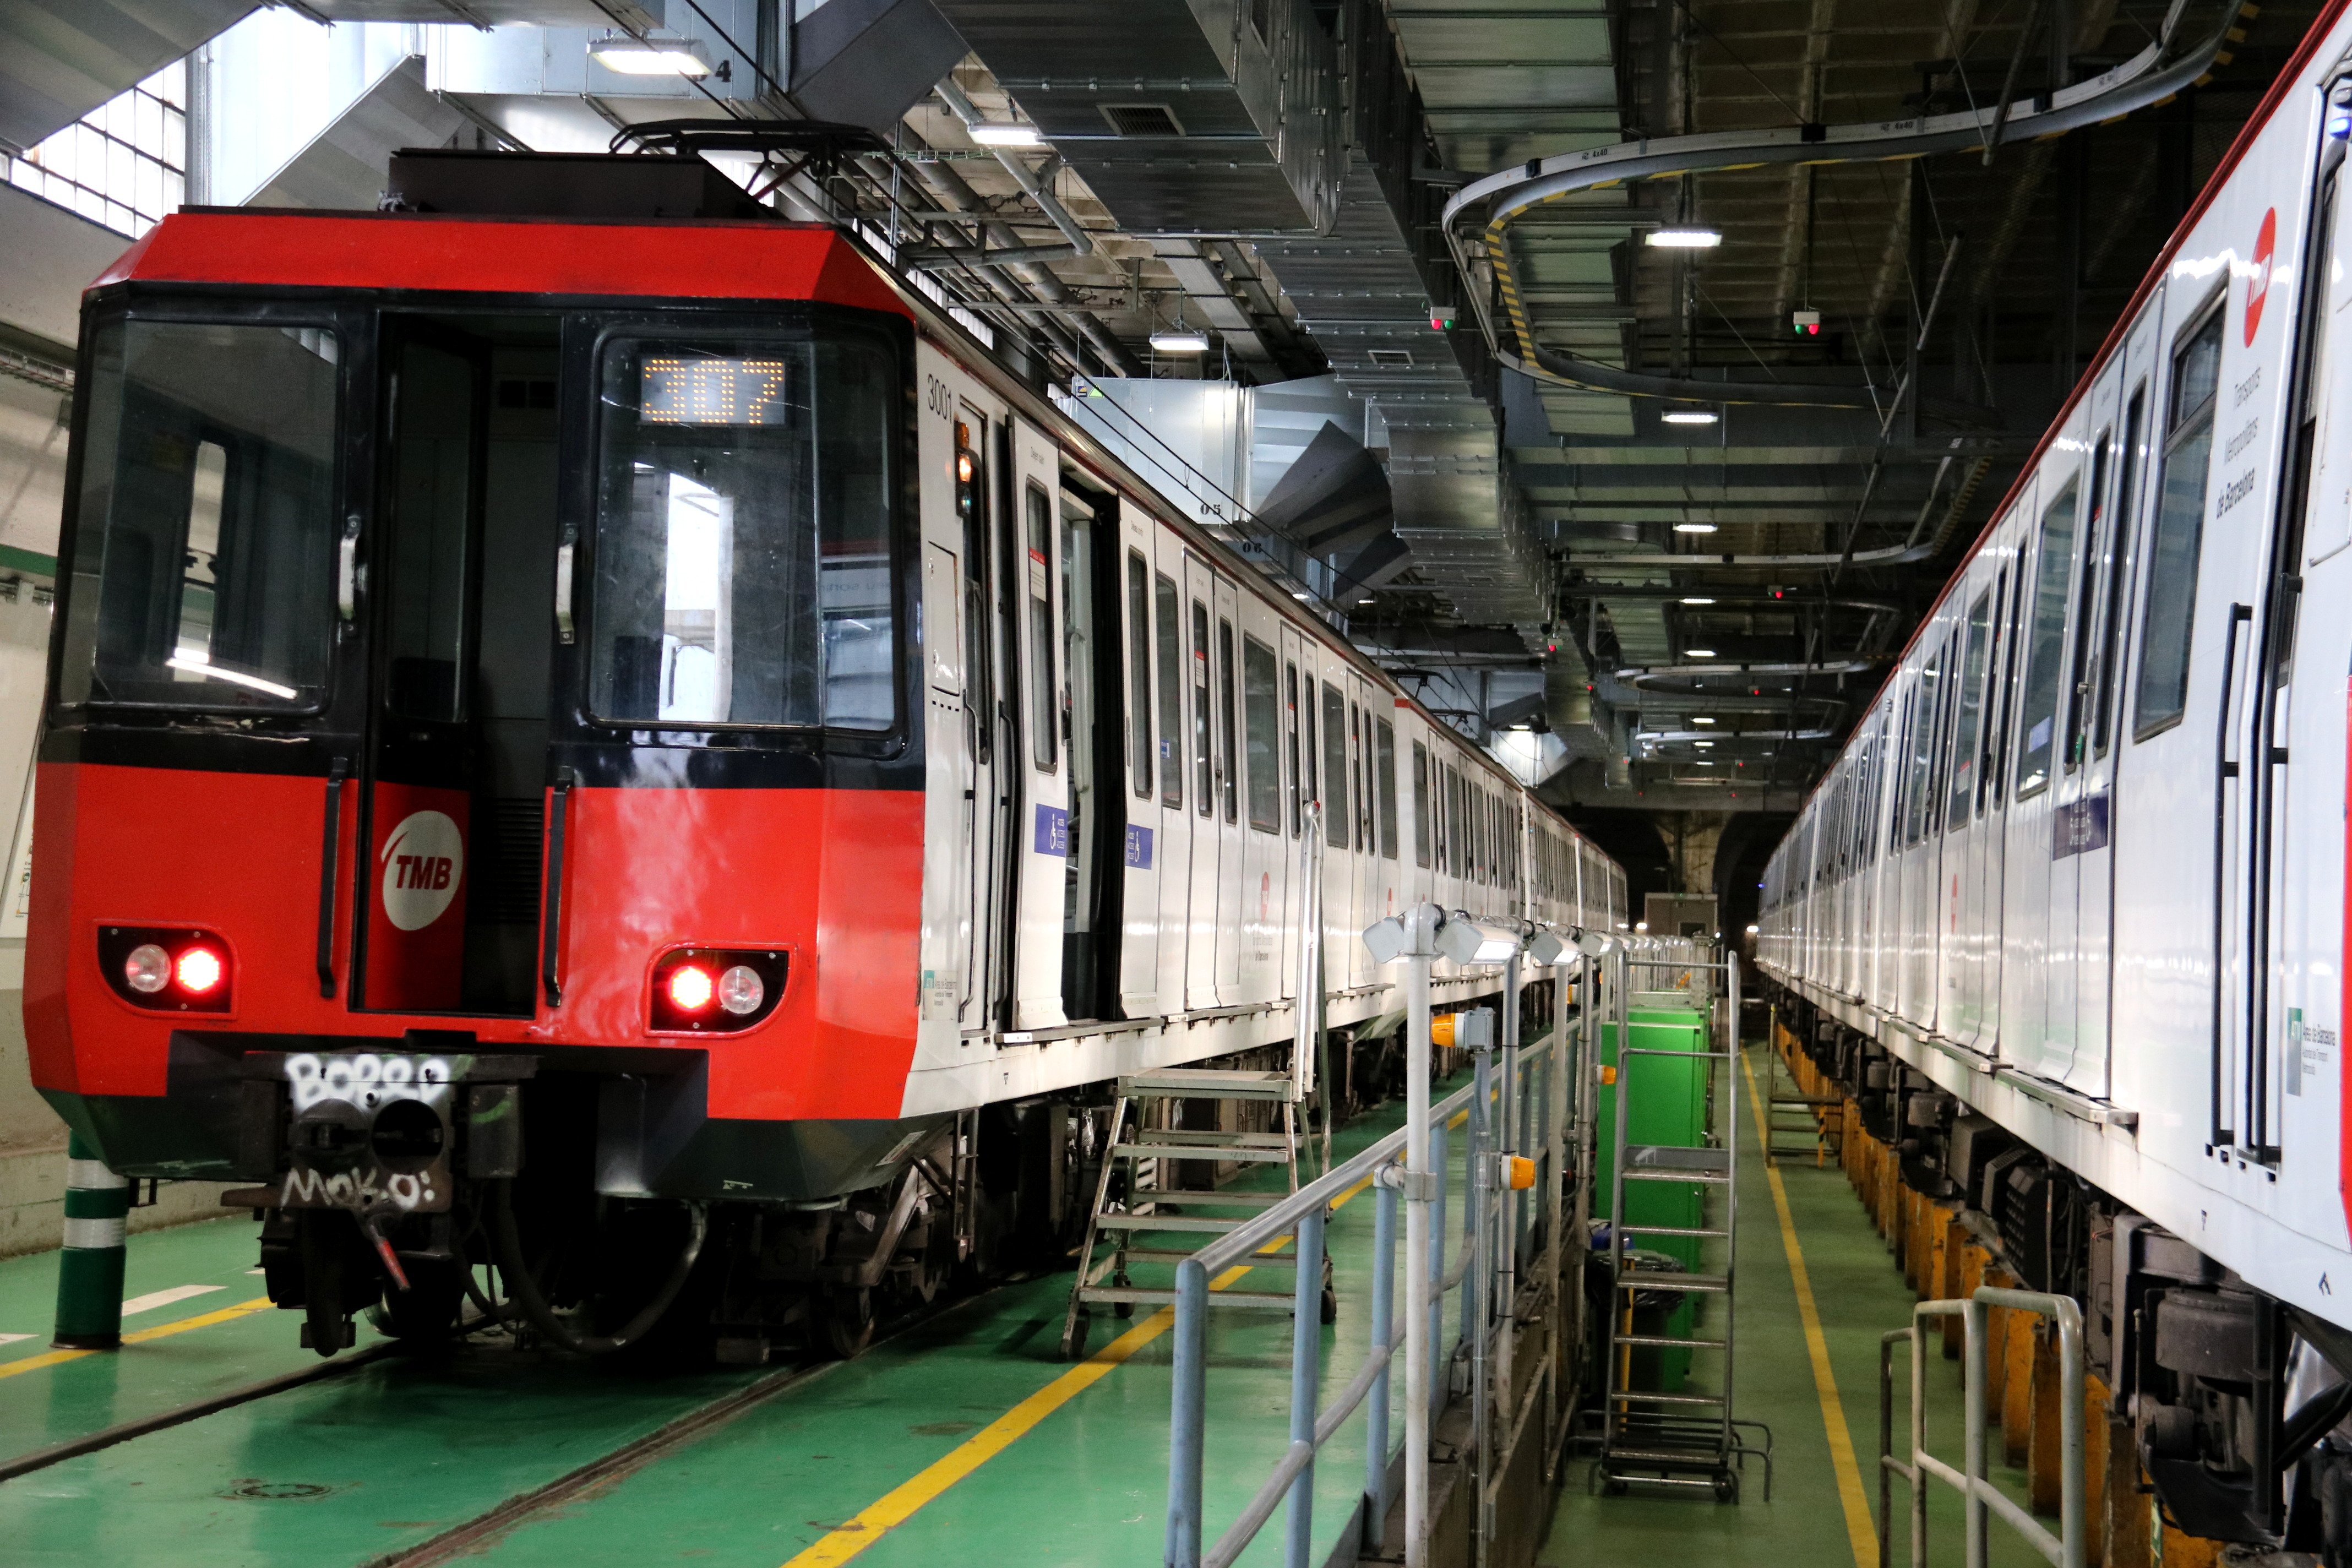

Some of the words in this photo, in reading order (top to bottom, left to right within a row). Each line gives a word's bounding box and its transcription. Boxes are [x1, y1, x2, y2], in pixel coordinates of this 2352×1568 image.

[644, 358, 785, 424] 307
[927, 373, 953, 424] 3001
[2217, 489, 2224, 520] de
[2224, 467, 2255, 513] Barcelona
[395, 855, 453, 891] TMB
